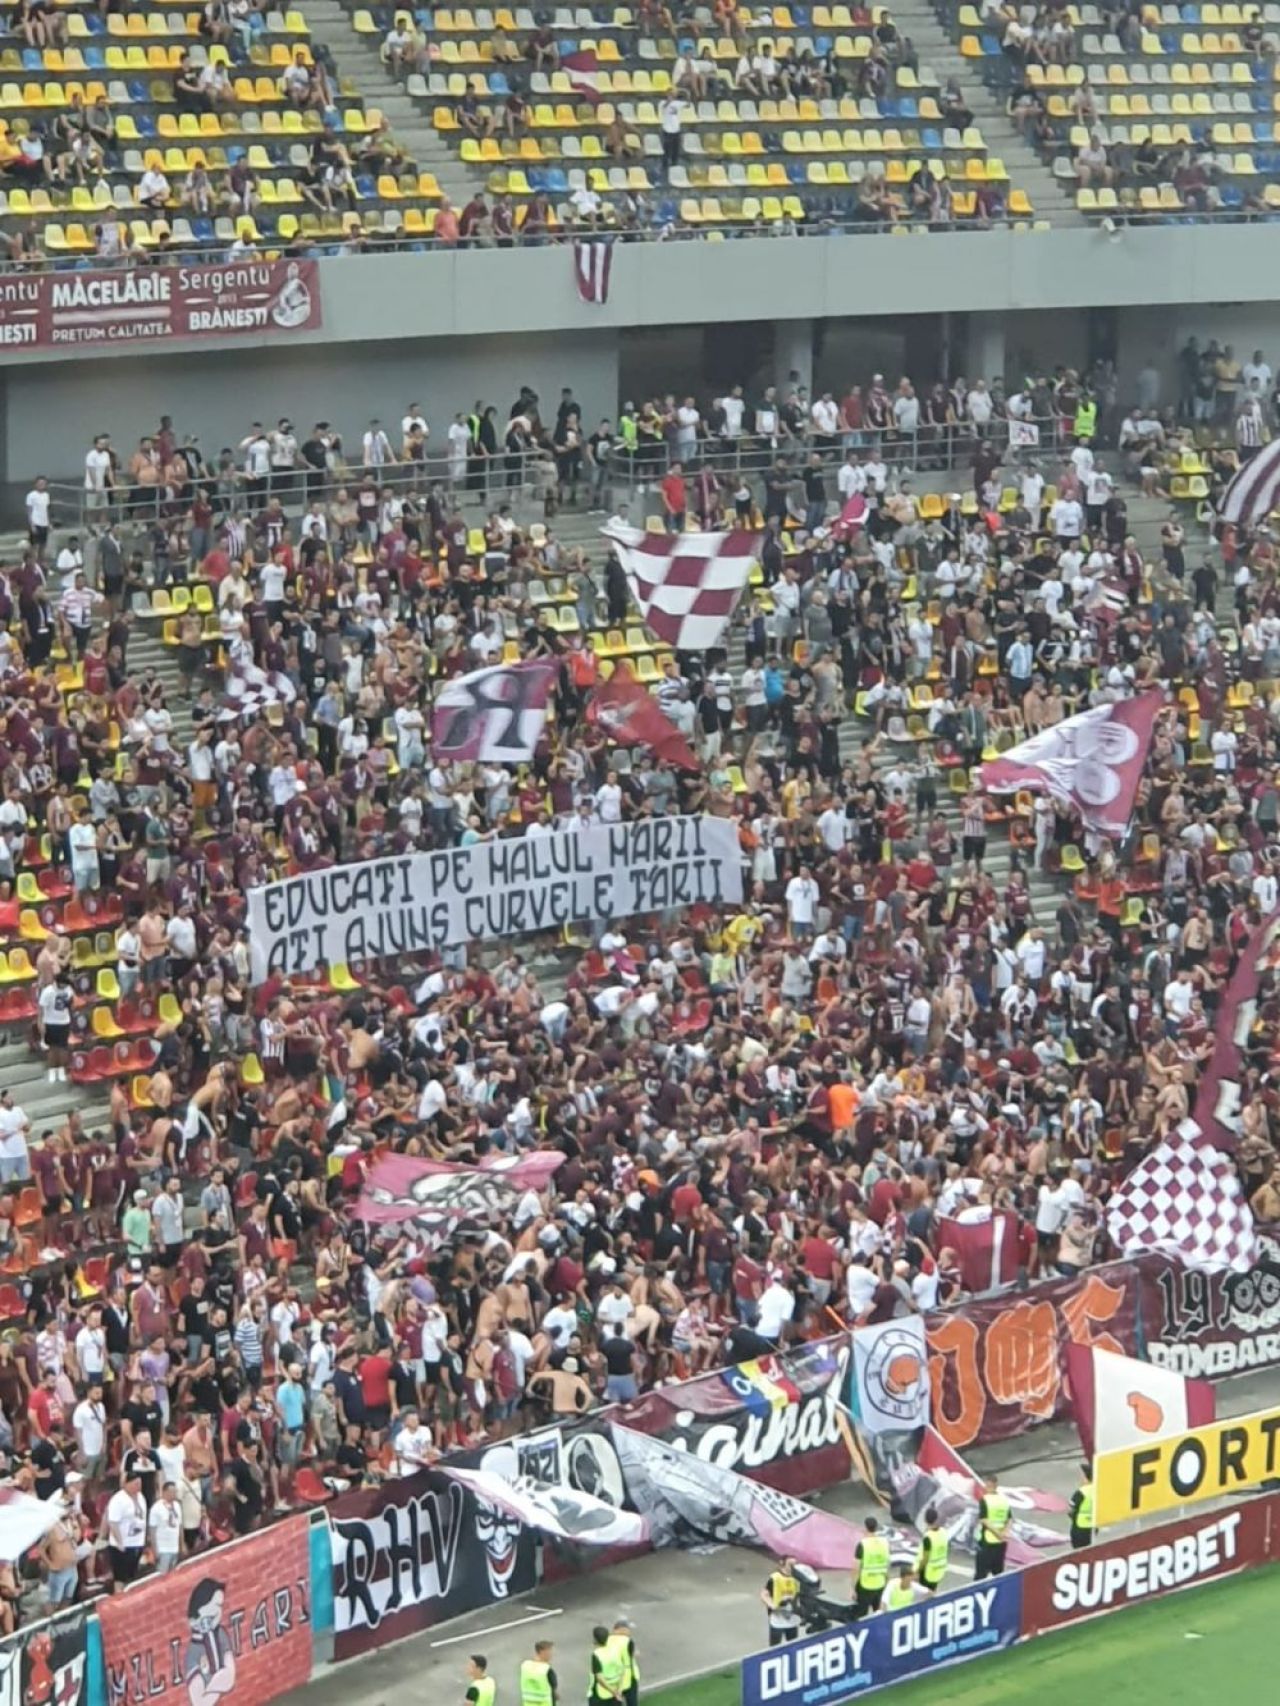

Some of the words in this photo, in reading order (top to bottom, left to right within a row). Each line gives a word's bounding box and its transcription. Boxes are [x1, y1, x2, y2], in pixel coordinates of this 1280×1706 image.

[108, 322, 172, 339] CALITATEA
[345, 902, 449, 963] AJUNS
[465, 873, 613, 938] CURVELE
[430, 850, 473, 897] PE
[1131, 1416, 1280, 1509] FORT
[1052, 1512, 1241, 1610] SUPERBET
